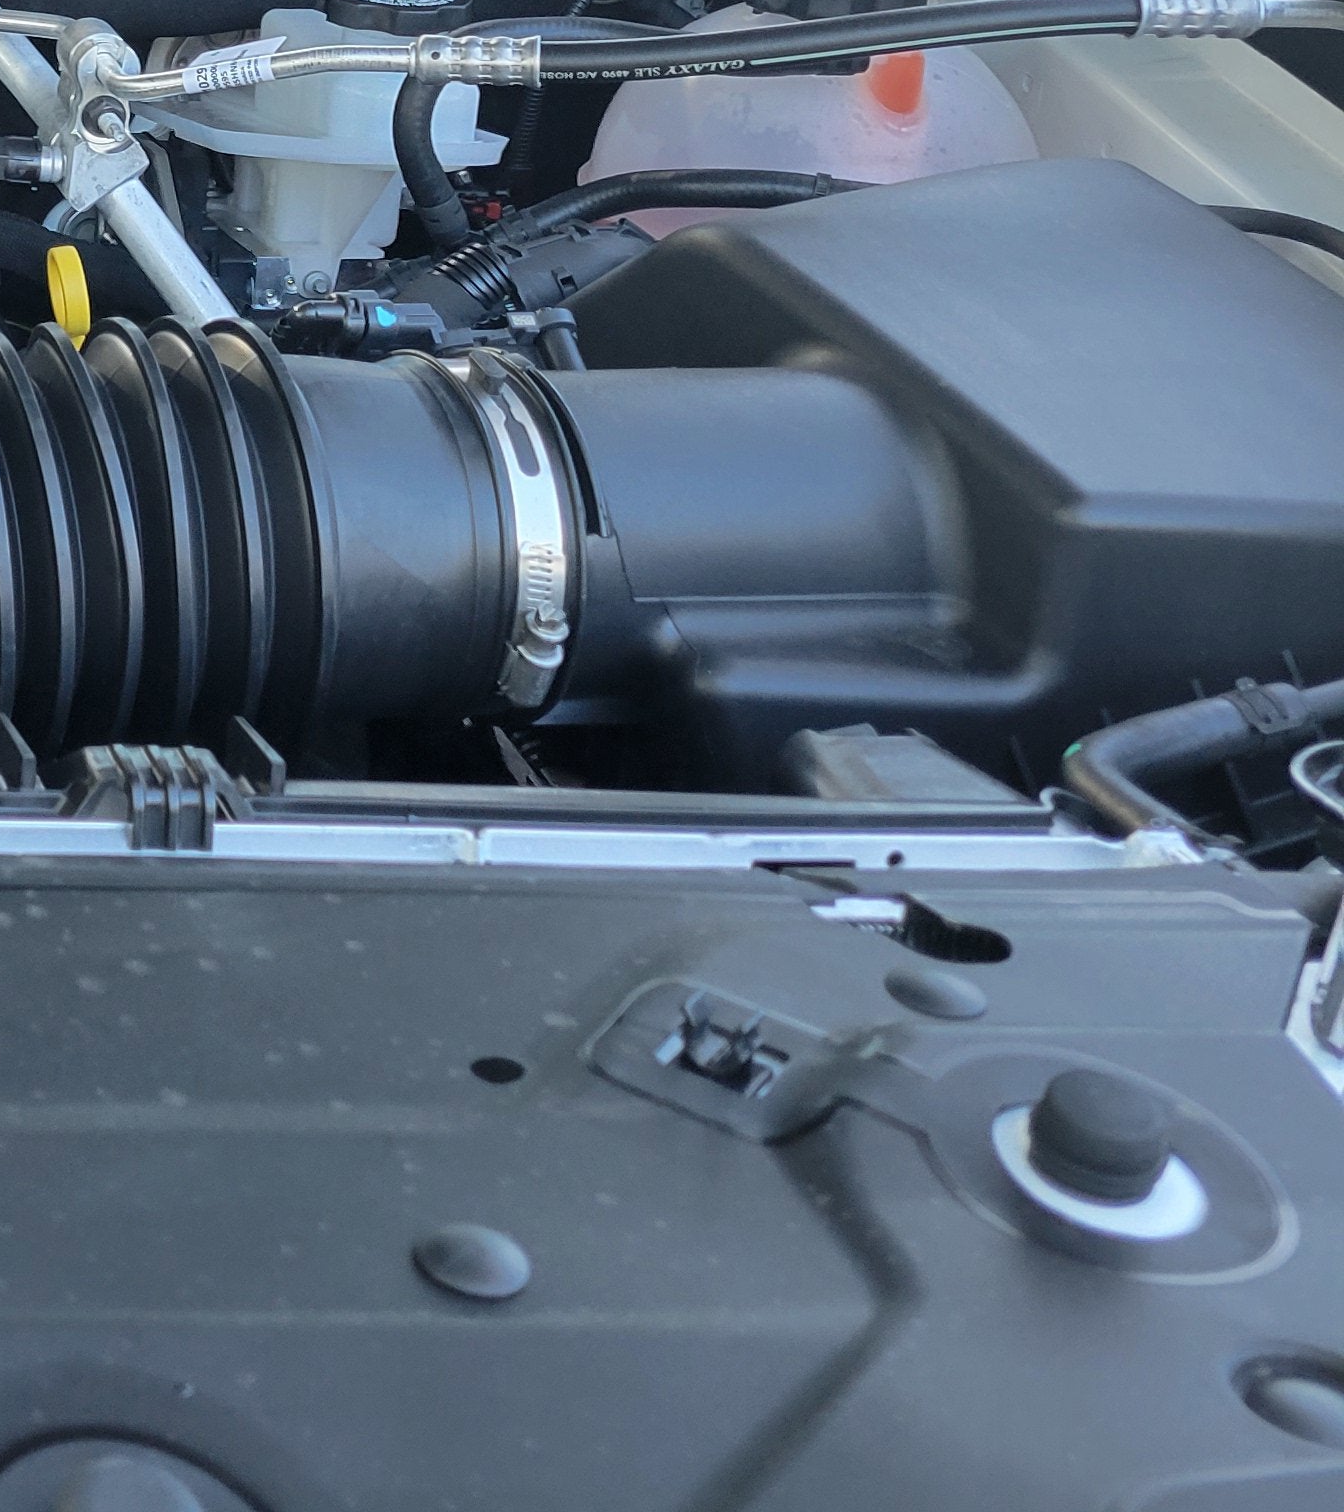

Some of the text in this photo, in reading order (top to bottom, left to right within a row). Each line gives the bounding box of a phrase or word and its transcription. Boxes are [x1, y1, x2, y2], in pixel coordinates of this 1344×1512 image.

[635, 67, 661, 78] SLE
[664, 59, 746, 76] GALAXY
[576, 71, 598, 80] A/C
